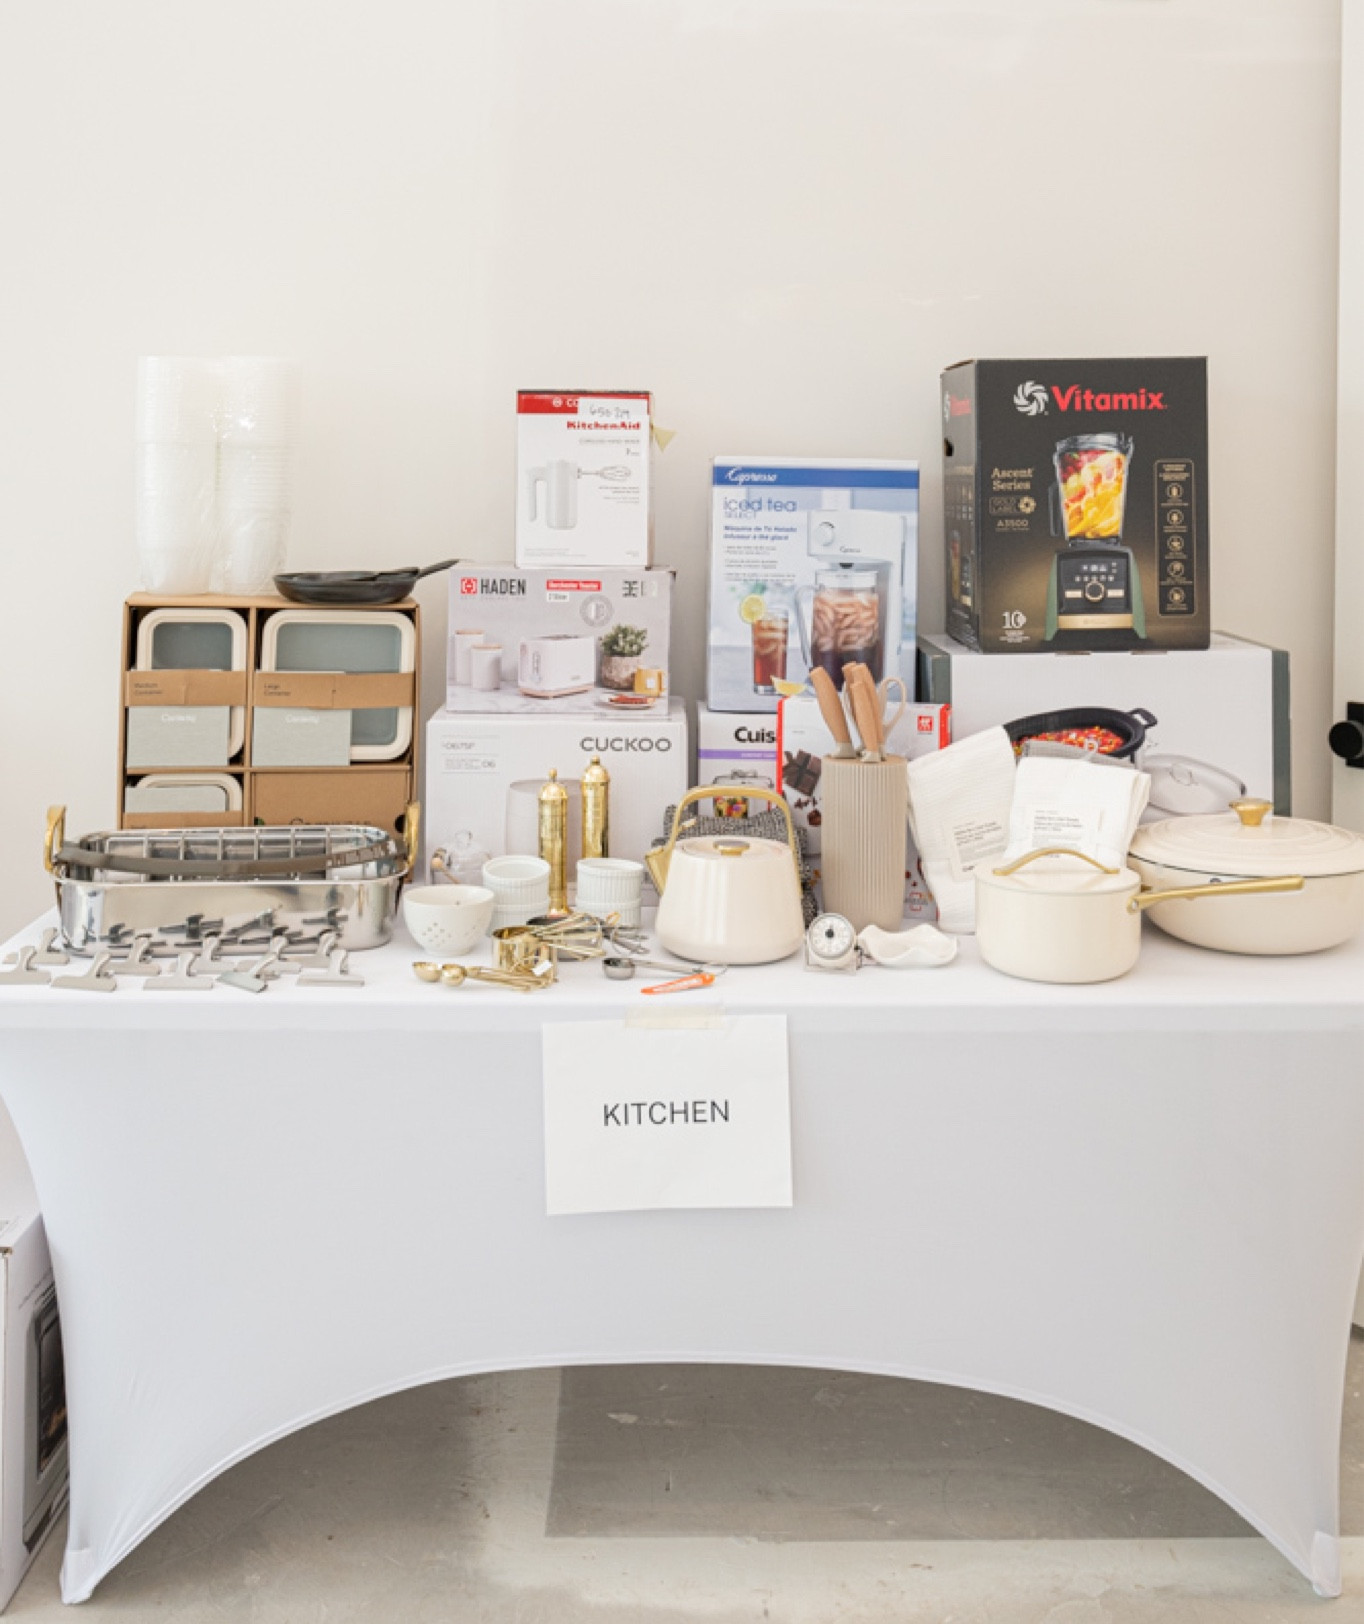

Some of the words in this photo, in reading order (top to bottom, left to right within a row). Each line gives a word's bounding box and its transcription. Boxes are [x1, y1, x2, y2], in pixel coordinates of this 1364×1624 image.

[1051, 384, 1164, 412] Vitamix
[567, 421, 640, 431] KitchenAid
[991, 467, 1033, 478] Ascent
[992, 480, 1031, 491] Series
[724, 497, 762, 512] iced
[767, 497, 798, 512] tea
[480, 578, 527, 595] HADEN
[579, 737, 673, 752] CUCKOO
[602, 1098, 731, 1127] KITCHEN
